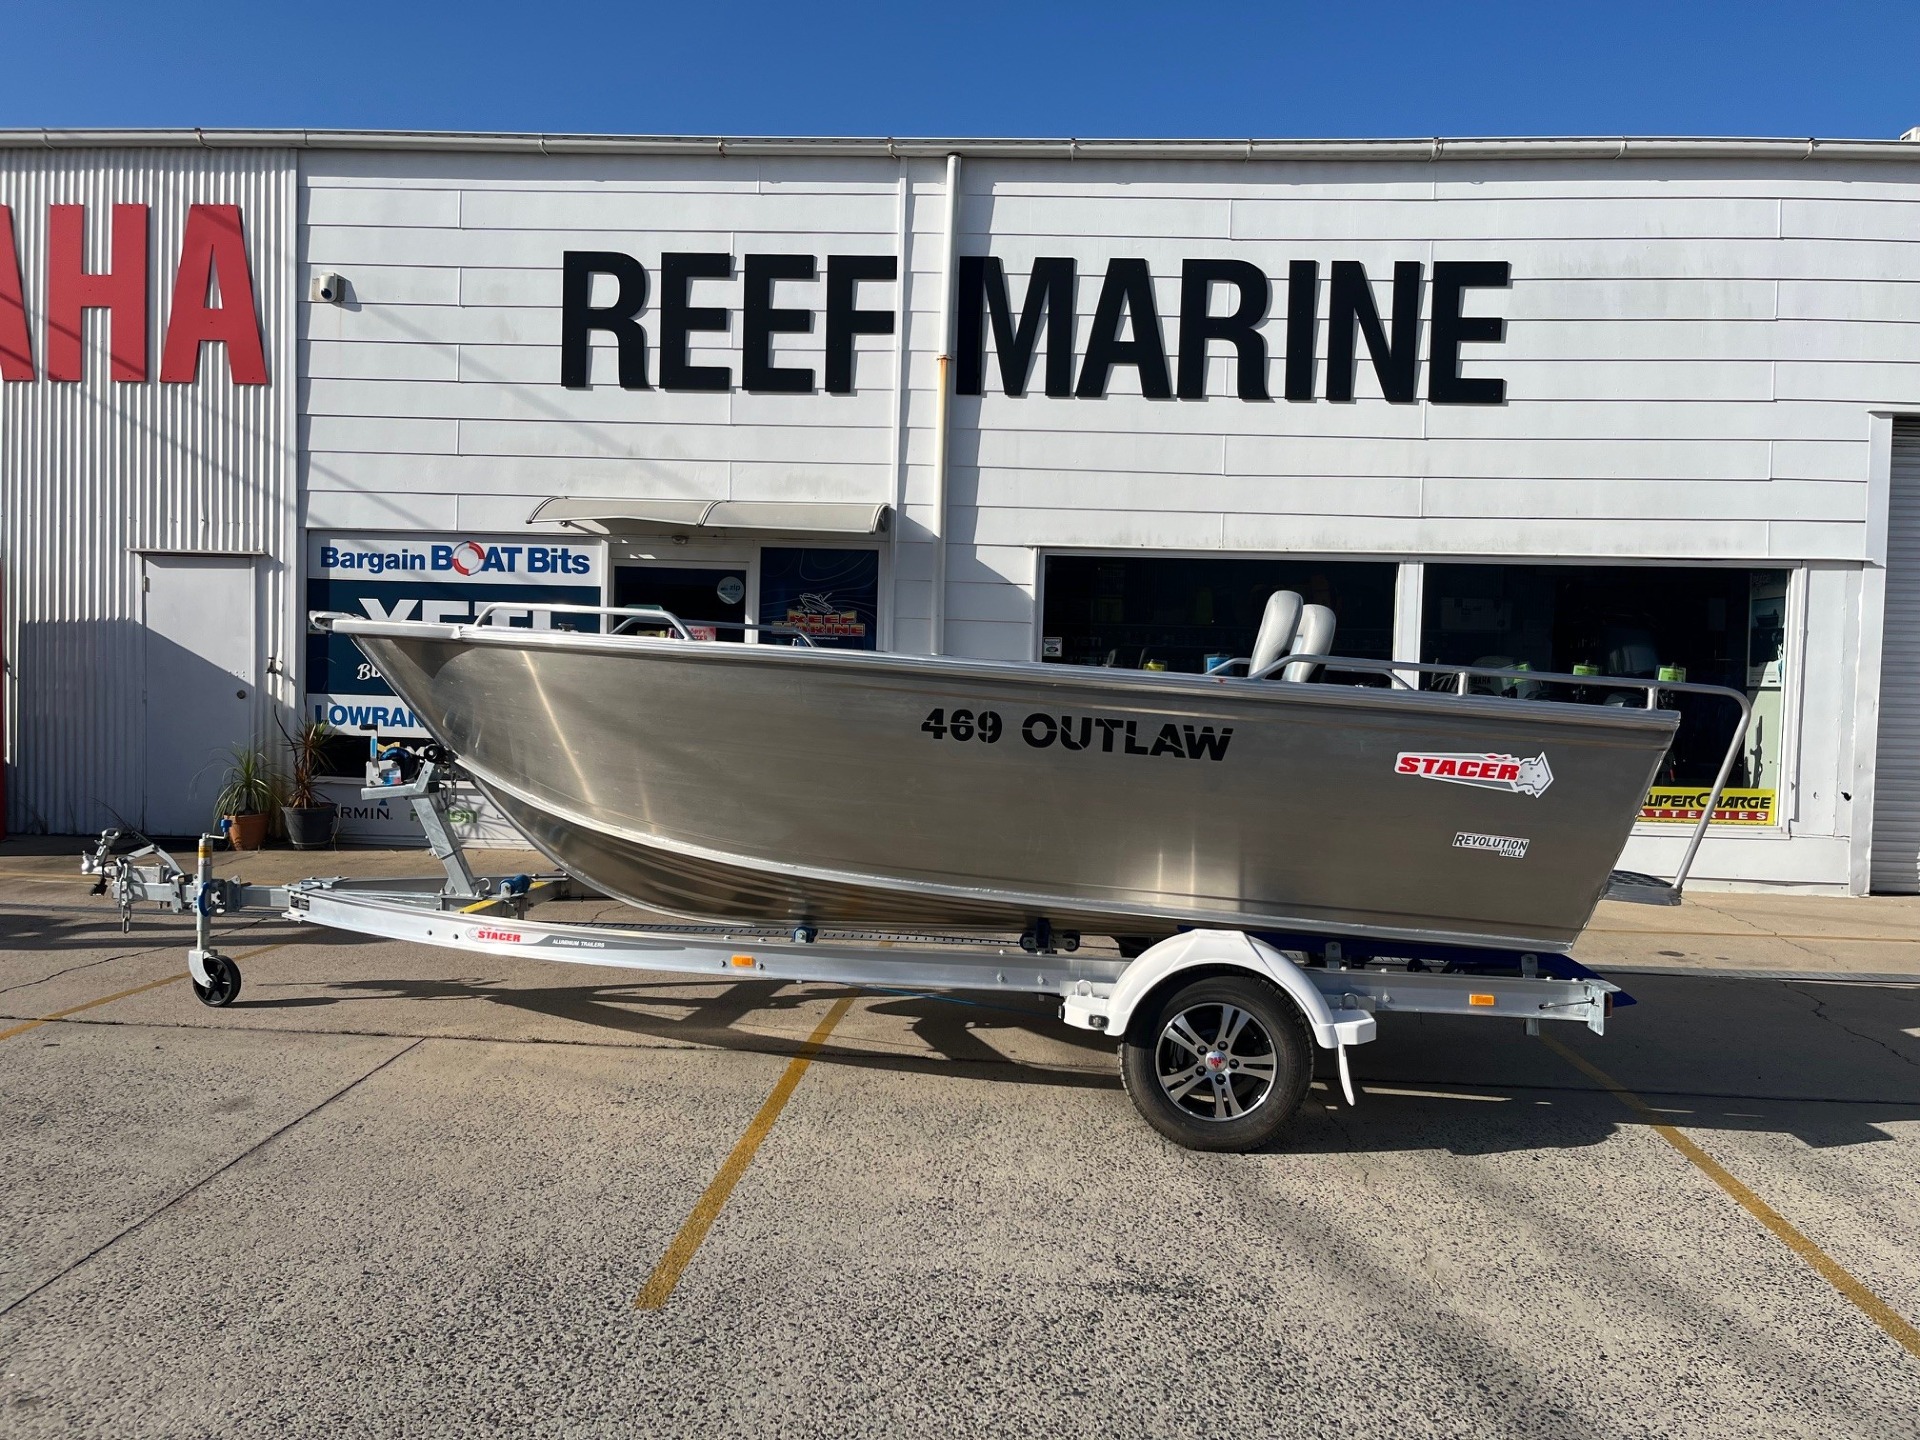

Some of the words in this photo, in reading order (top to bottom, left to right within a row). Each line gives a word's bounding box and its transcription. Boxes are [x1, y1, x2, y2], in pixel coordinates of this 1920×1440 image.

[561, 250, 897, 394] REEF
[956, 256, 1512, 403] MARINE
[320, 547, 425, 572] Bargain
[431, 541, 522, 576] BOAT
[527, 548, 590, 574] Bits
[787, 609, 857, 625] REEF
[314, 704, 424, 728] LOWRAN
[921, 708, 1003, 743] 469
[1021, 712, 1234, 761] OUTLAW
[1398, 756, 1520, 780] STACER
[1453, 834, 1528, 850] REVOLUTION
[1501, 848, 1524, 858] HULL
[478, 930, 521, 943] STACER
